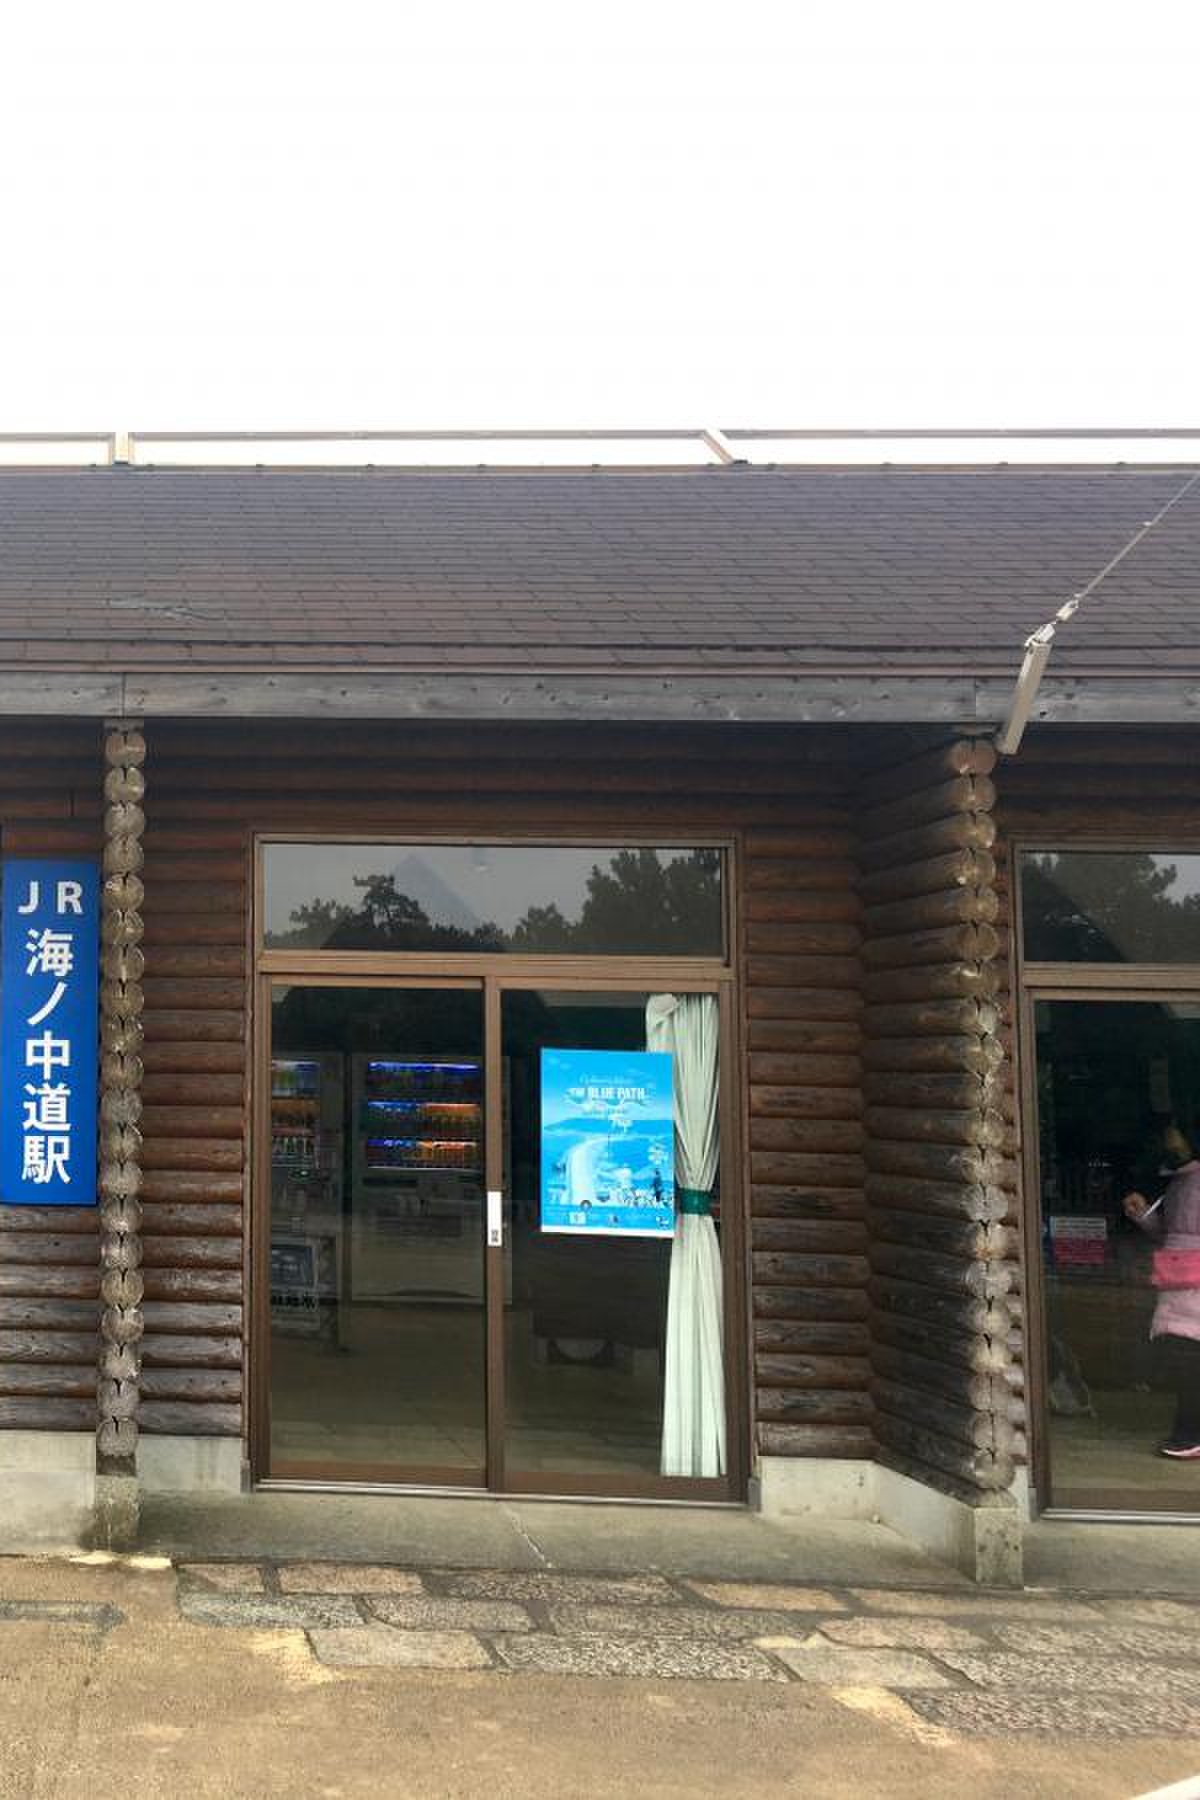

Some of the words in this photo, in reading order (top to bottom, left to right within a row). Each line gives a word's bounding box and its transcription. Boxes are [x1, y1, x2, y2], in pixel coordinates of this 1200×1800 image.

[18, 880, 84, 914] JR
[22, 928, 74, 1184] 海ノ中道駅
[587, 1087, 614, 1100] BLUE
[617, 1087, 645, 1099] PATH
